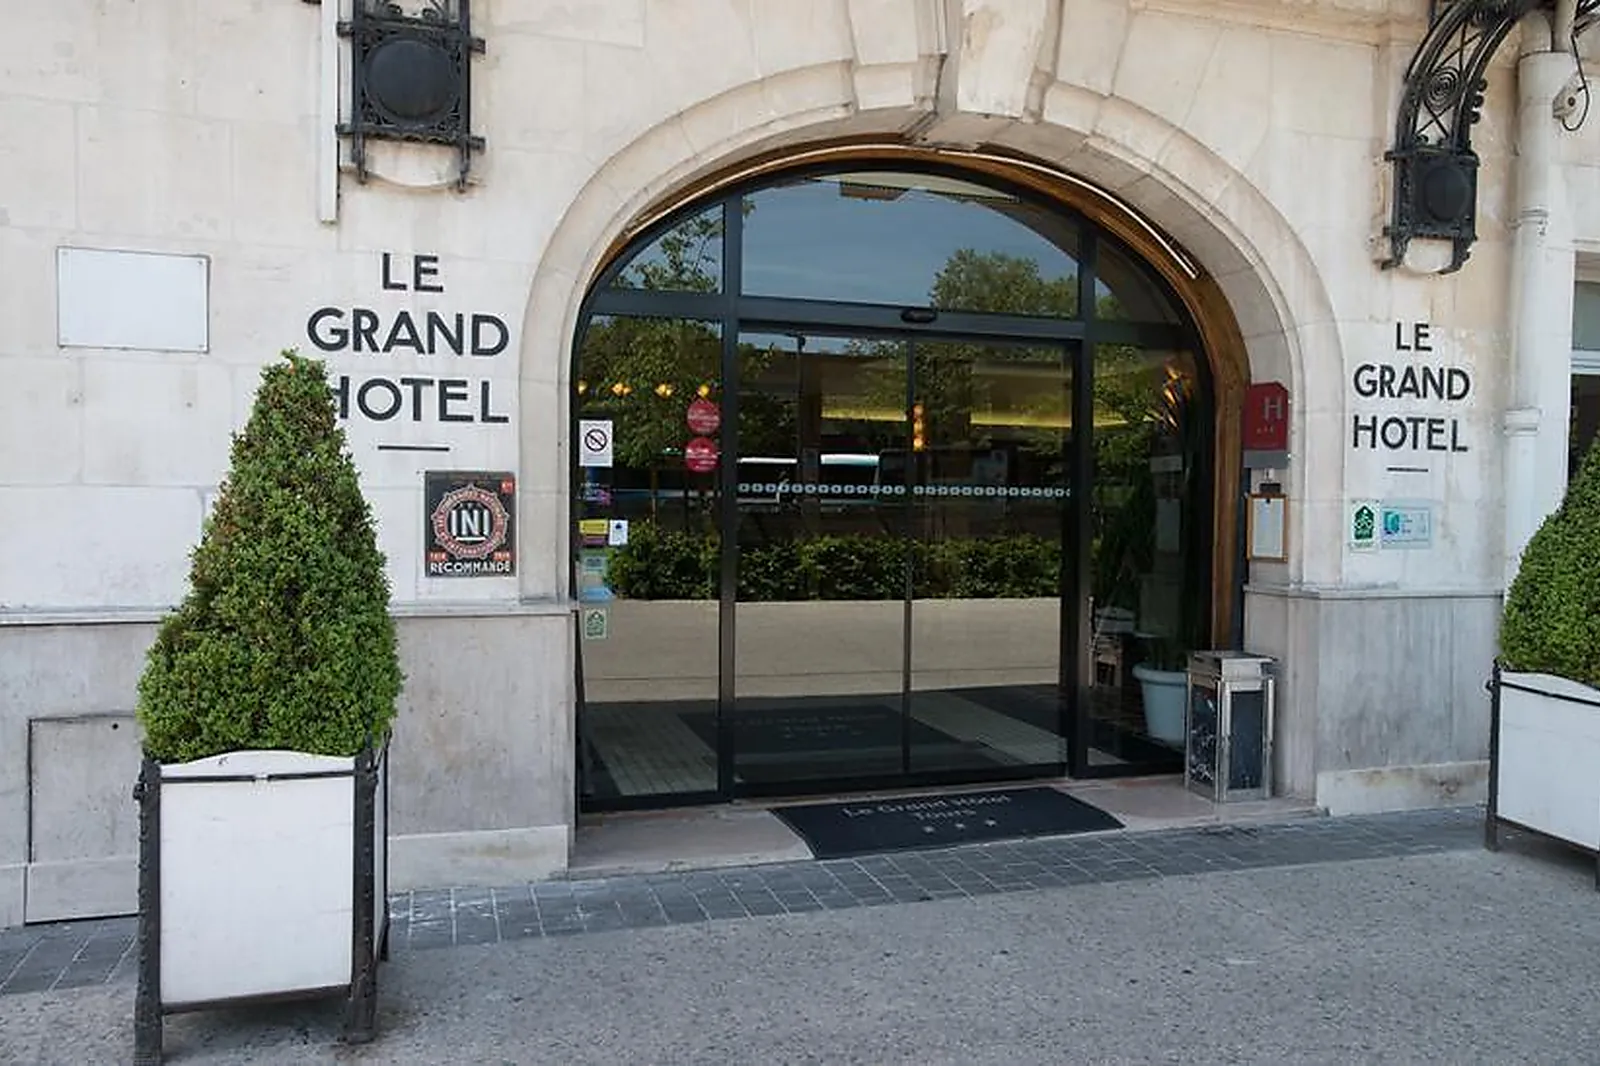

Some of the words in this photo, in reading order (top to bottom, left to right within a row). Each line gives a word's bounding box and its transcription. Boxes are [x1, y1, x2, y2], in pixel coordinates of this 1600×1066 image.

[383, 252, 443, 293] LE
[307, 308, 508, 356] GRAND
[1397, 322, 1432, 351] LE
[1354, 364, 1469, 401] GRAND
[1263, 395, 1283, 422] H
[1354, 415, 1467, 452] HOTEL
